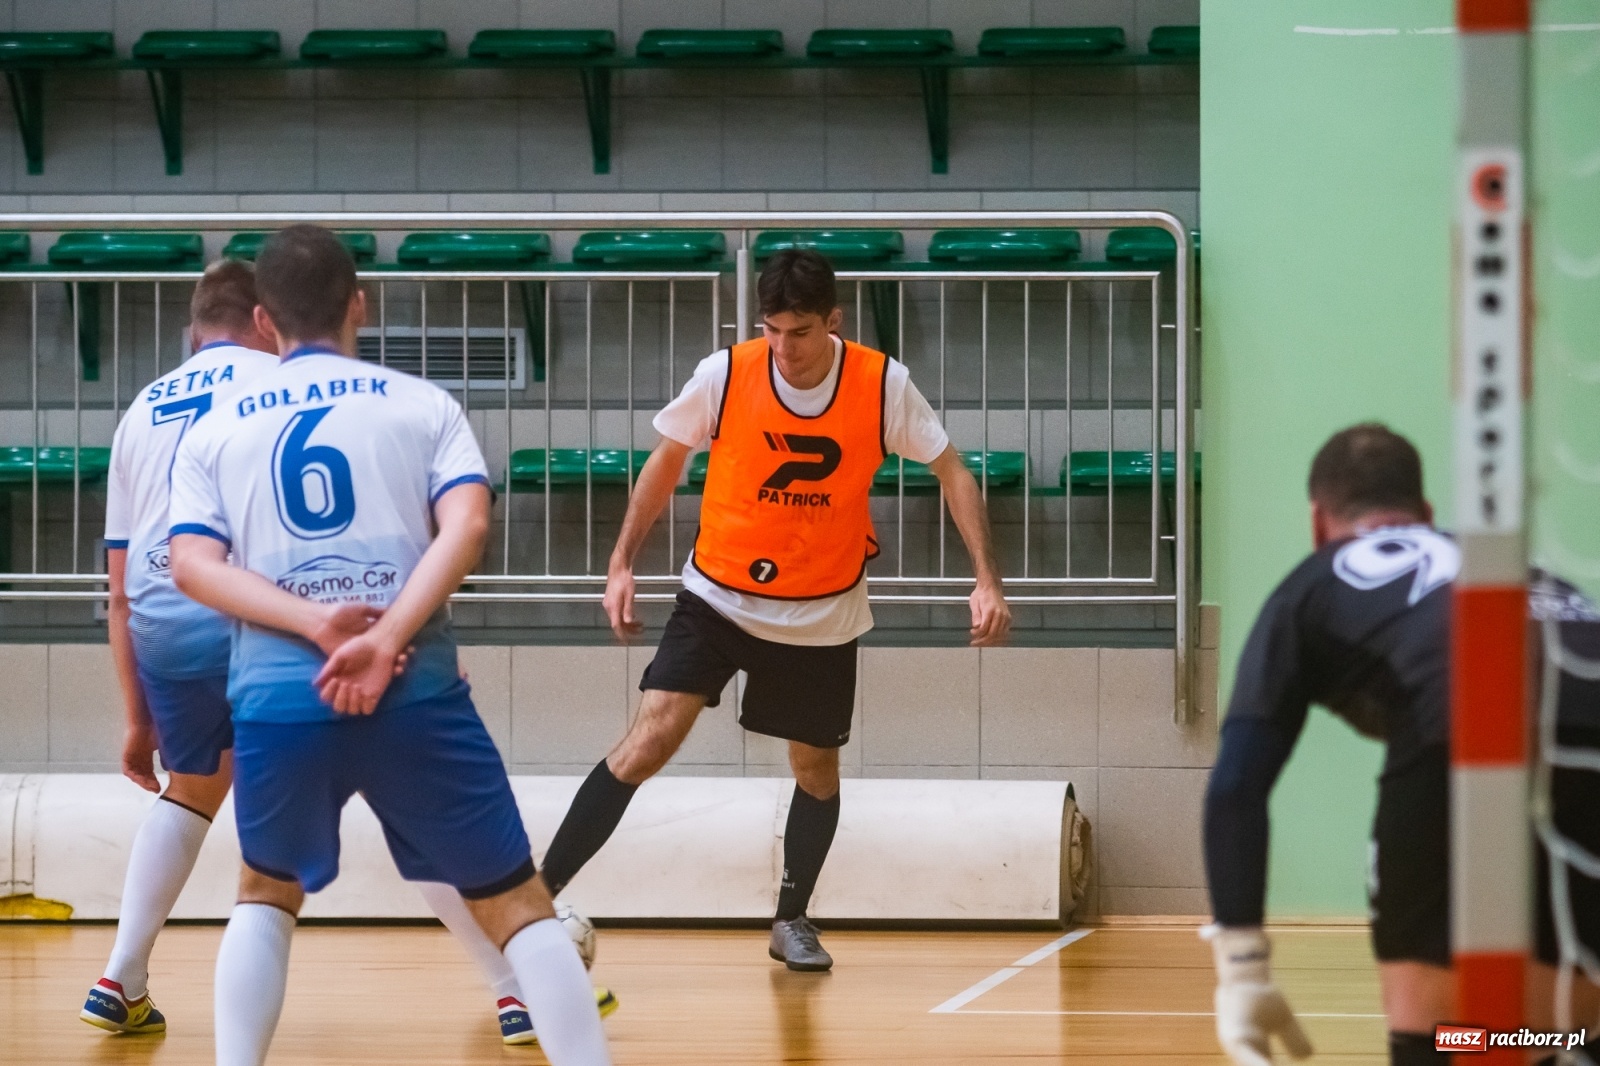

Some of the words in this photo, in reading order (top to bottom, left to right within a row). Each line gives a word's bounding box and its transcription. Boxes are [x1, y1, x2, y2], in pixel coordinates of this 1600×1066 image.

[147, 364, 235, 402] SETKA
[271, 405, 356, 541] 6
[757, 488, 832, 507] PATRICK
[757, 561, 773, 582] 7
